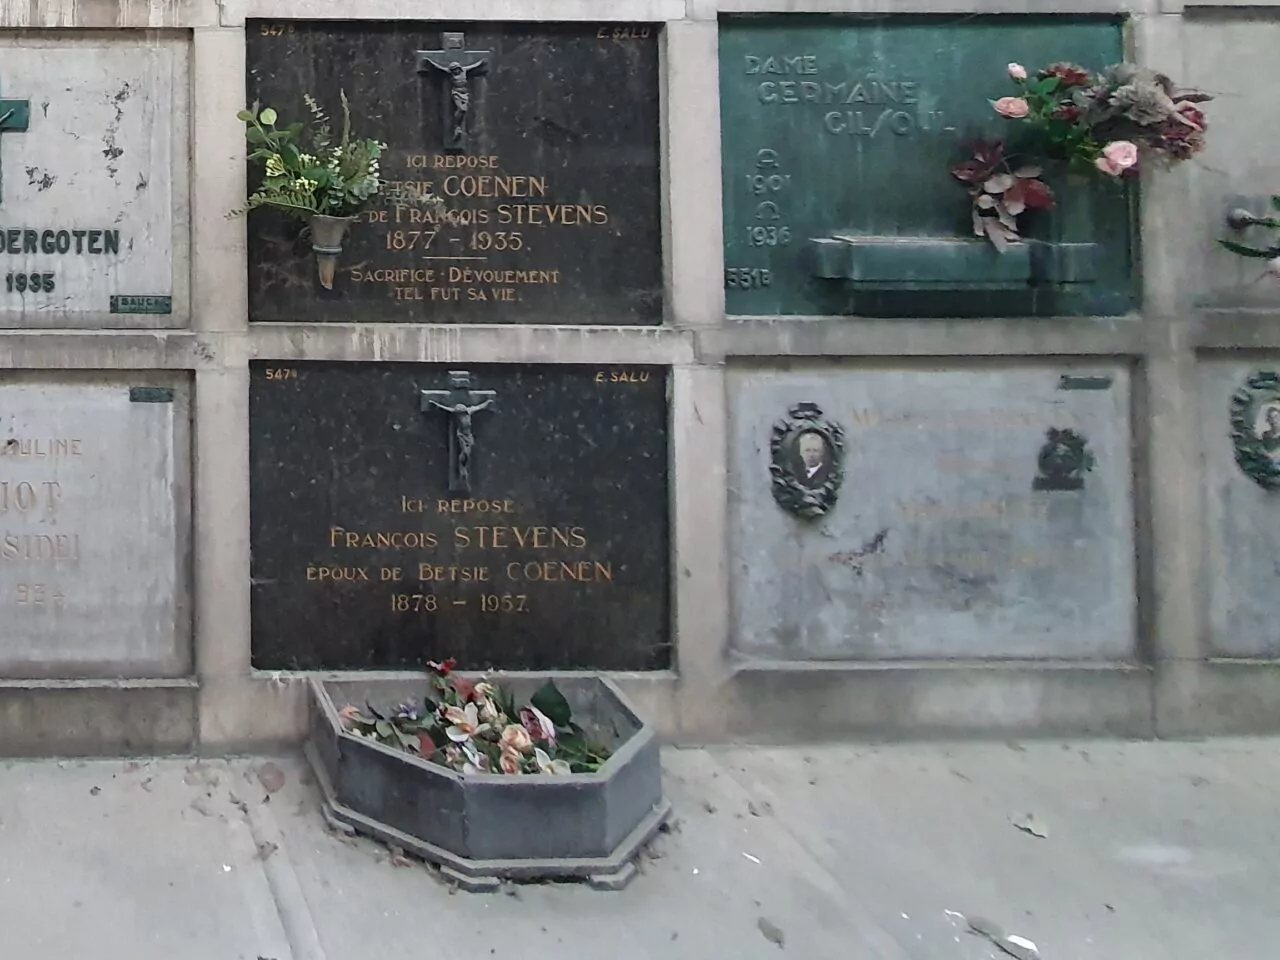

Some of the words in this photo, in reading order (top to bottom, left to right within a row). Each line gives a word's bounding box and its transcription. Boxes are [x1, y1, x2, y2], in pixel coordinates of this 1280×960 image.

[744, 55, 818, 76] DAME
[759, 80, 919, 105] GERMAINE
[407, 155, 427, 168] ICI
[433, 155, 500, 169] REPOSE
[378, 181, 434, 195] ETSIE
[443, 175, 546, 198] COENEN
[370, 210, 388, 224] DE
[497, 204, 609, 225] STEVENS
[386, 230, 437, 250] 1877
[746, 226, 791, 247] 1936
[5, 272, 56, 293] 1935
[351, 268, 436, 283] SACRIFICE
[449, 266, 561, 284] DÉVOUEMENT
[395, 287, 421, 301] TEL
[430, 287, 462, 301] FUT
[467, 288, 487, 301] SA
[610, 371, 651, 383] SALU
[401, 494, 425, 513] ICI
[438, 497, 516, 514] REPOSE
[330, 525, 438, 552] FRANÇOIS
[454, 525, 588, 549] STEVENS
[381, 566, 403, 582] DE
[419, 563, 489, 582] BETSIE
[507, 560, 613, 583] COENEN
[391, 593, 438, 612] 1878
